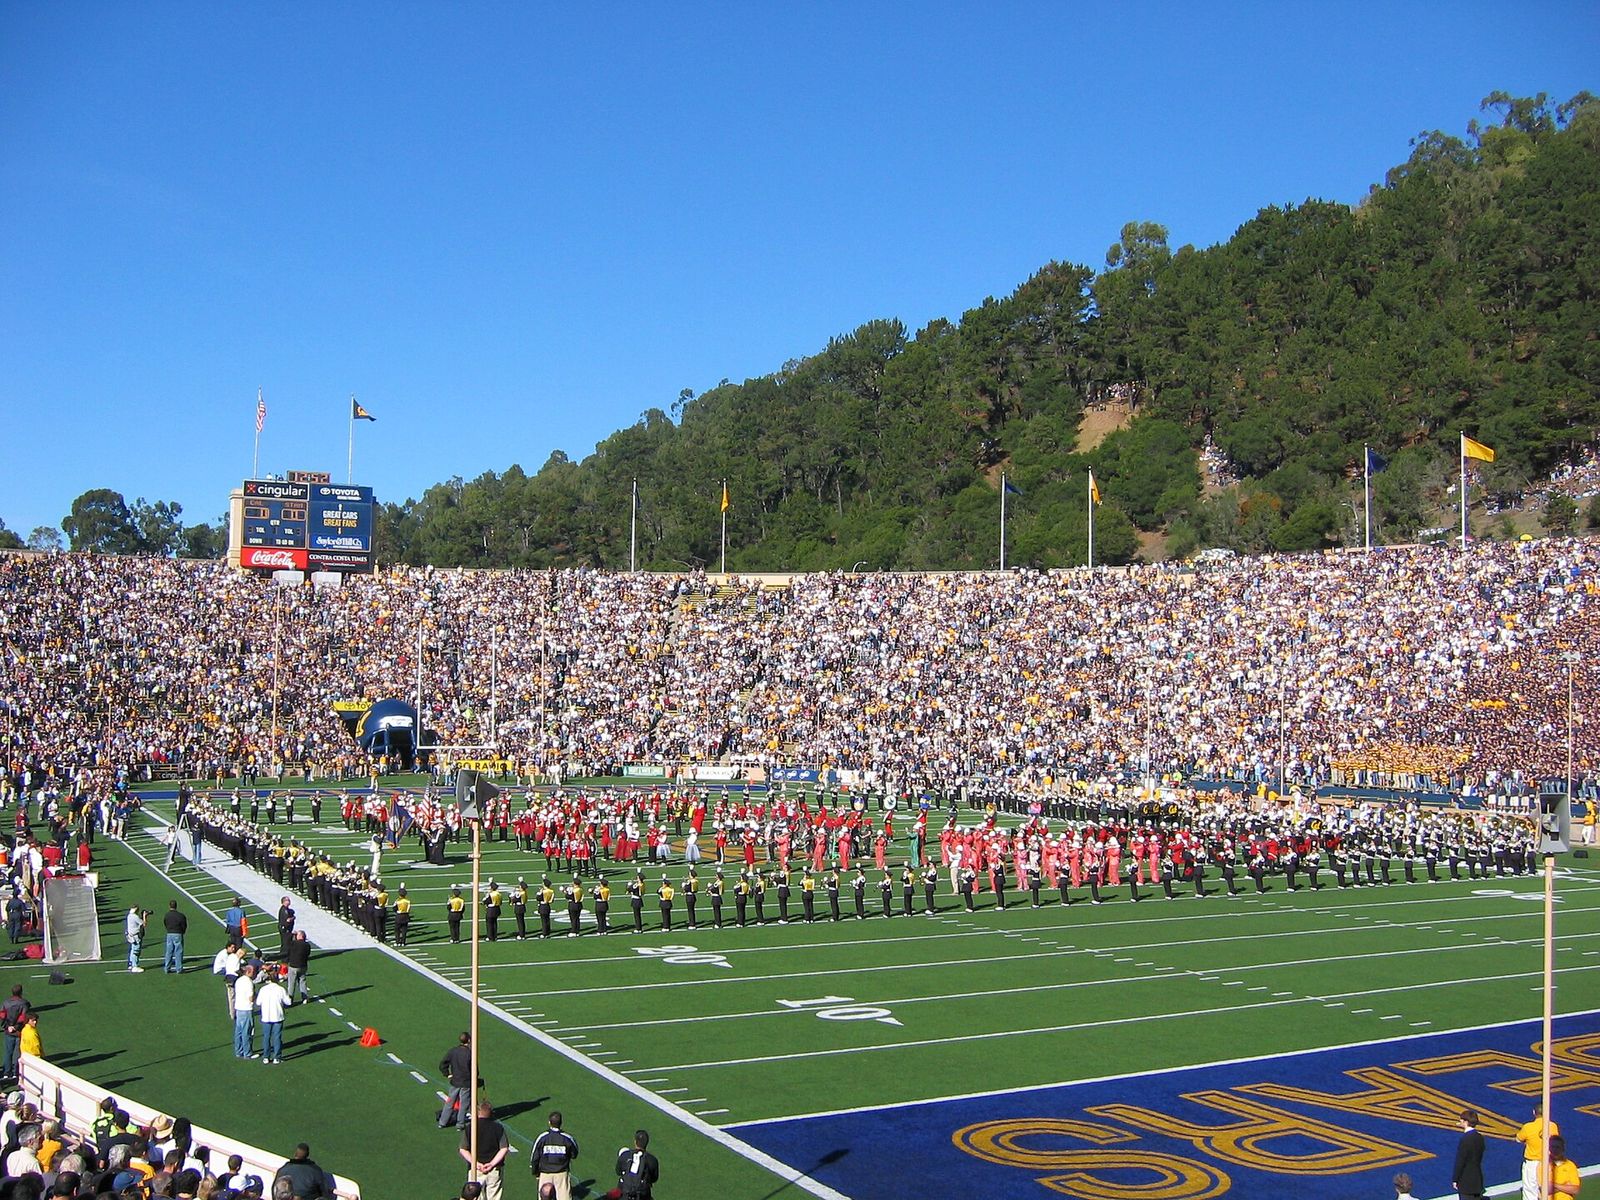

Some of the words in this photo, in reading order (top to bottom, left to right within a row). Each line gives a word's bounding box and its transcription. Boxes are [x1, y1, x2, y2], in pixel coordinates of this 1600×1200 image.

[294, 472, 329, 483] 12:52
[258, 485, 303, 497] cingular
[323, 511, 341, 519] GREAT
[342, 511, 358, 519] CARS
[324, 519, 342, 527] GREAT
[477, 762, 508, 771] RAIO
[631, 945, 727, 964] 20
[776, 996, 892, 1020] 10
